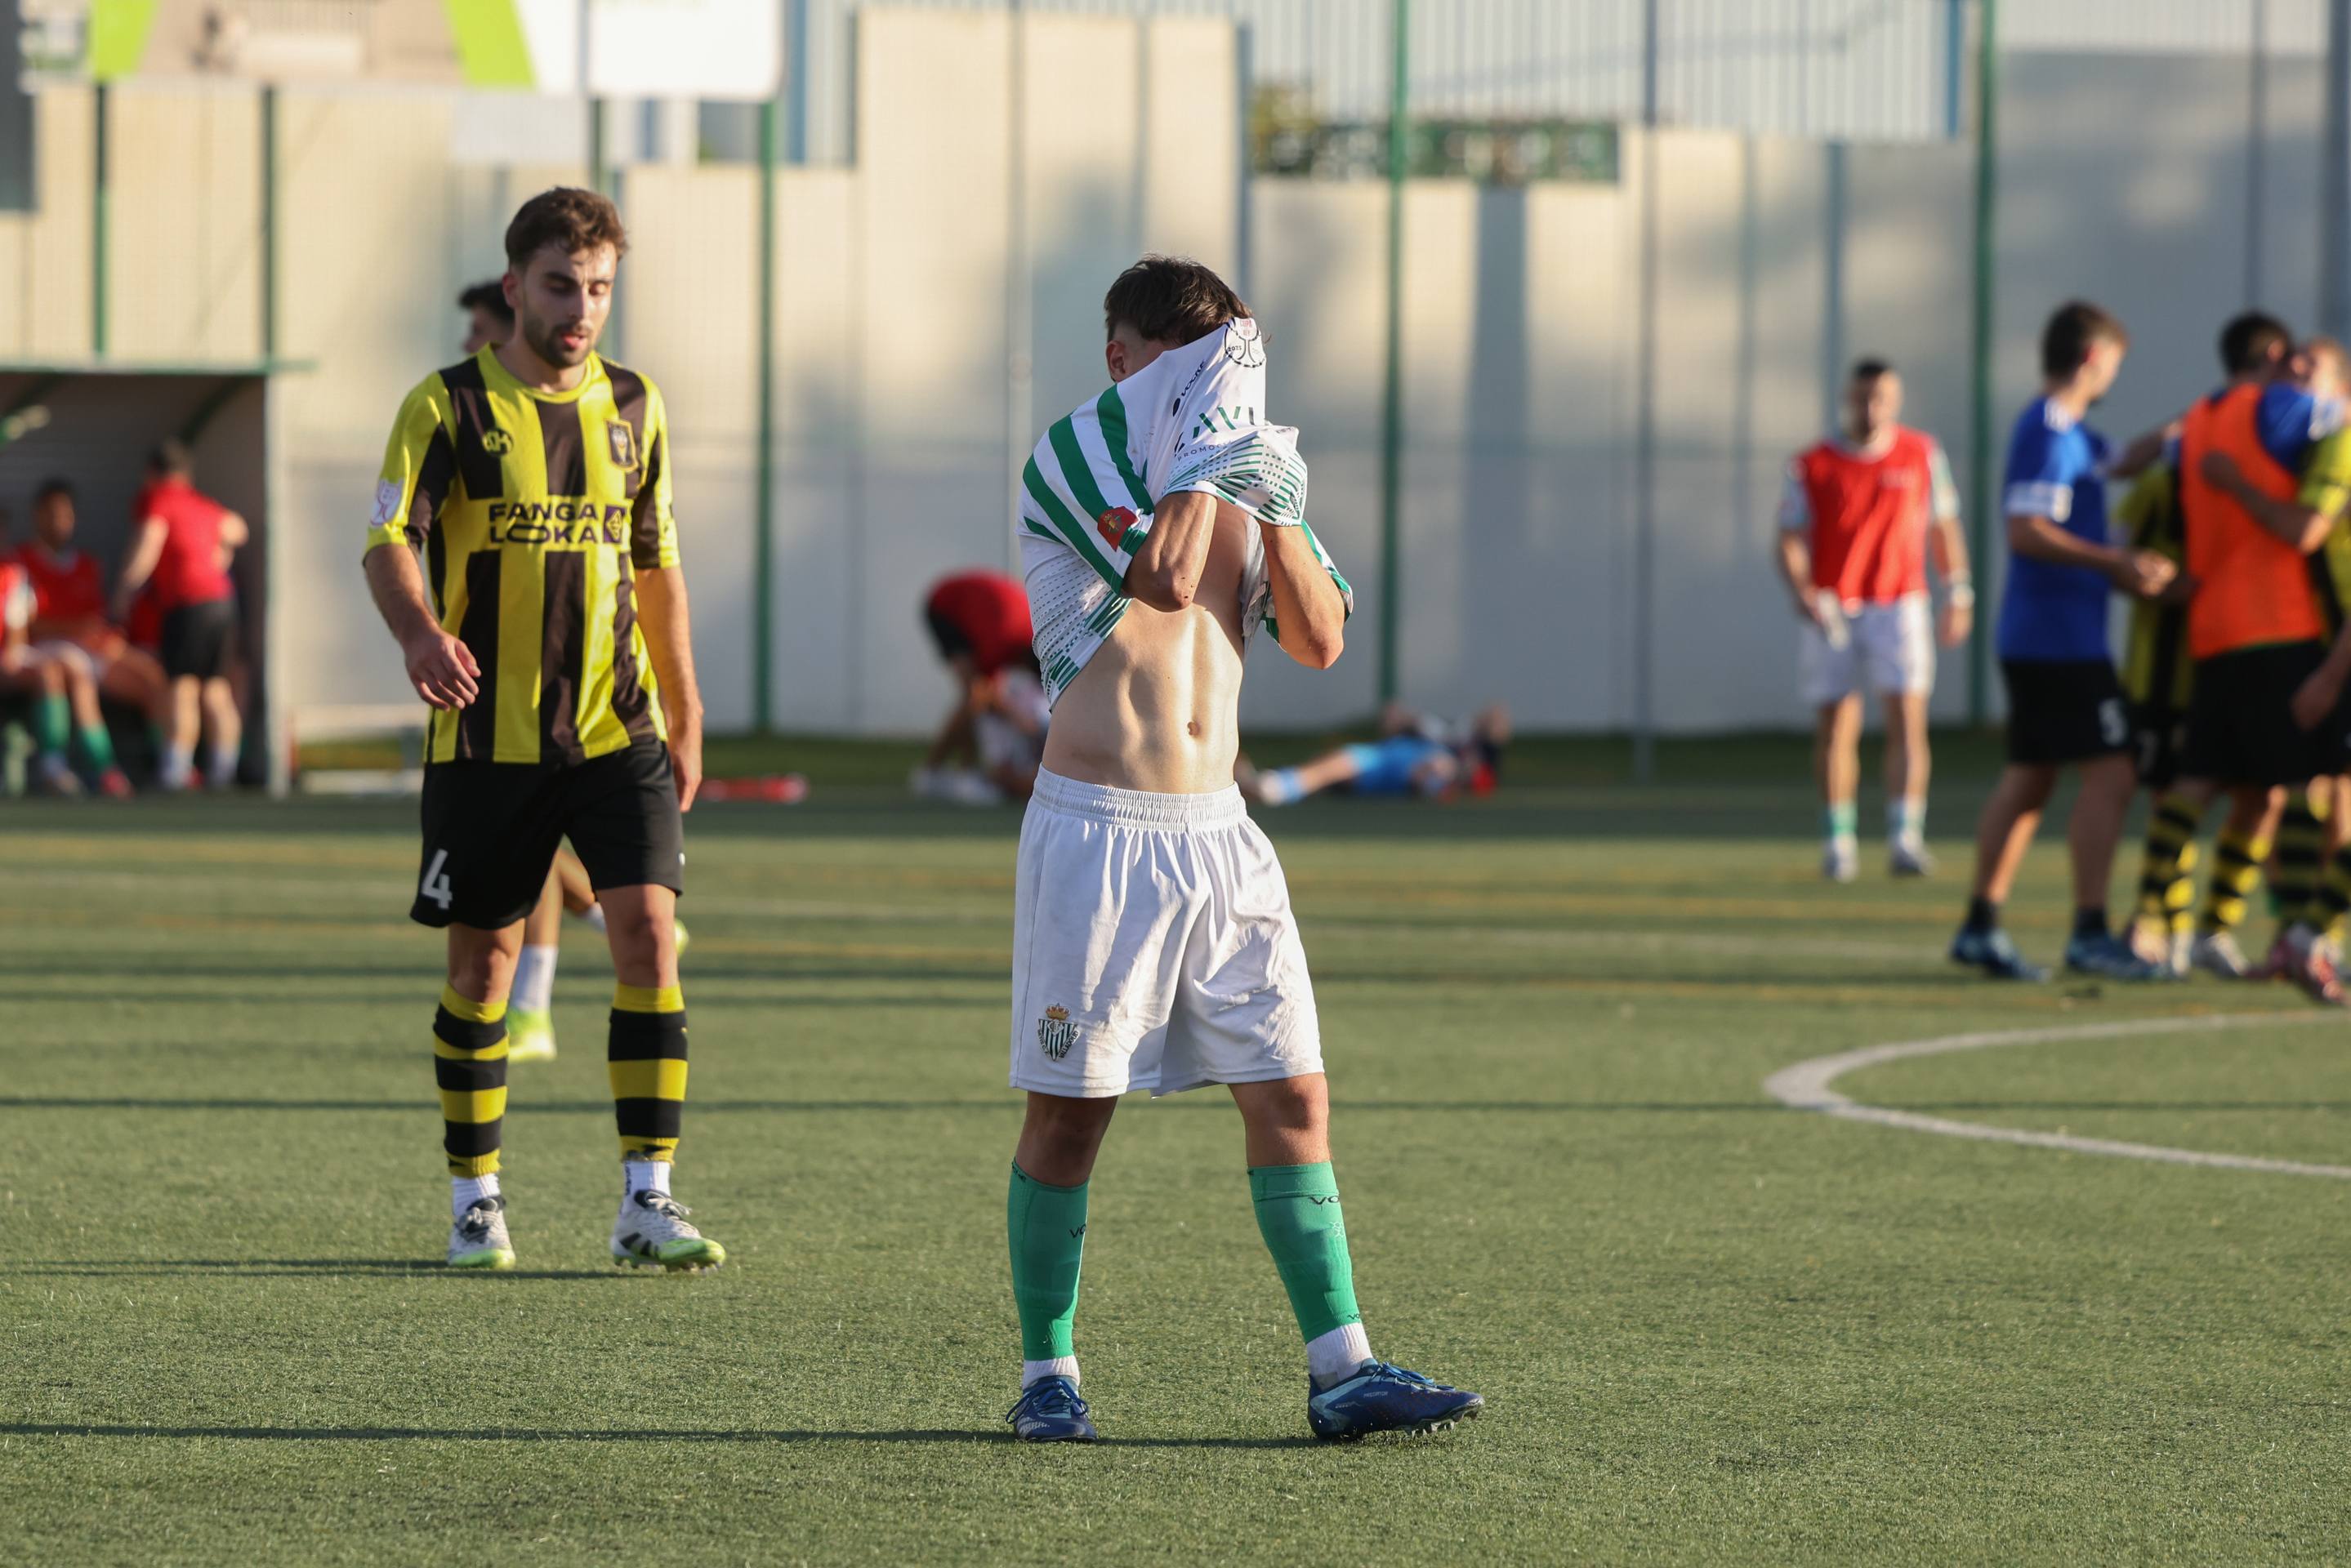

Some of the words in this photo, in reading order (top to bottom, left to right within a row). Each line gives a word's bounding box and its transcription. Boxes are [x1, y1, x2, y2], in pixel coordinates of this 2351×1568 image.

[488, 502, 597, 522] FANGA
[490, 523, 597, 544] LOKA
[422, 849, 453, 909] 4
